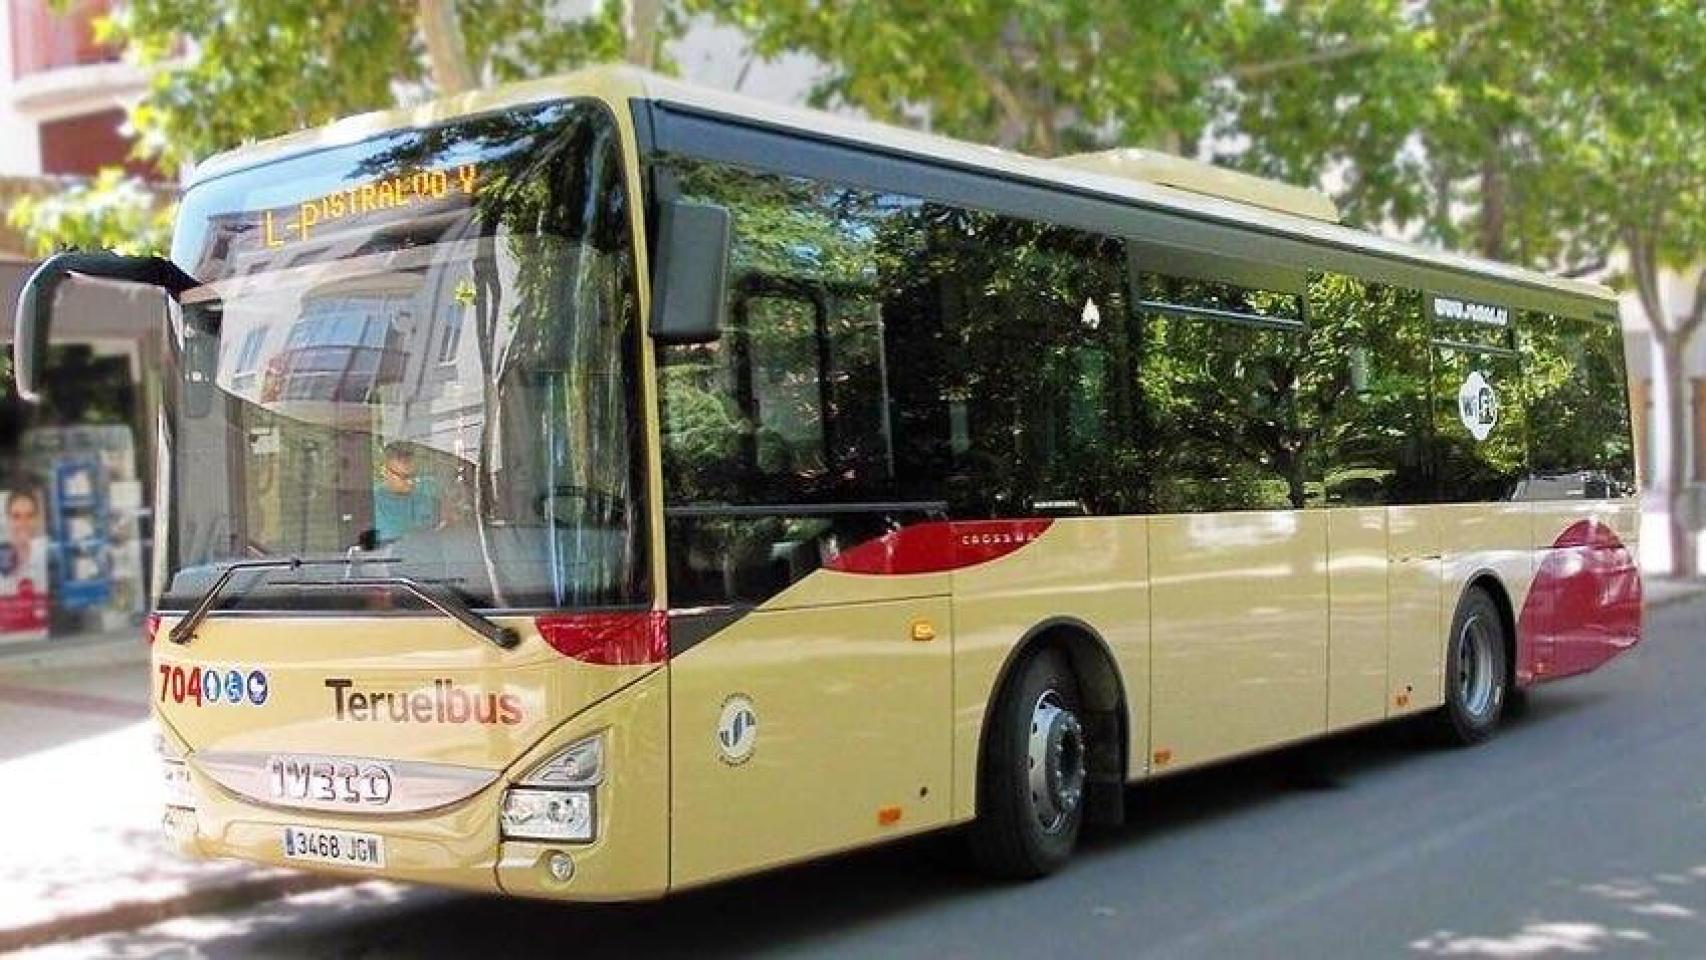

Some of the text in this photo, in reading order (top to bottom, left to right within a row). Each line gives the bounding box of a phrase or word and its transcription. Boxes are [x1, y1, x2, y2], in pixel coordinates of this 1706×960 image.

[160, 665, 201, 706] 704
[325, 679, 523, 725] Teruelbus
[270, 759, 394, 806] IVECO
[296, 832, 341, 861] 3468
